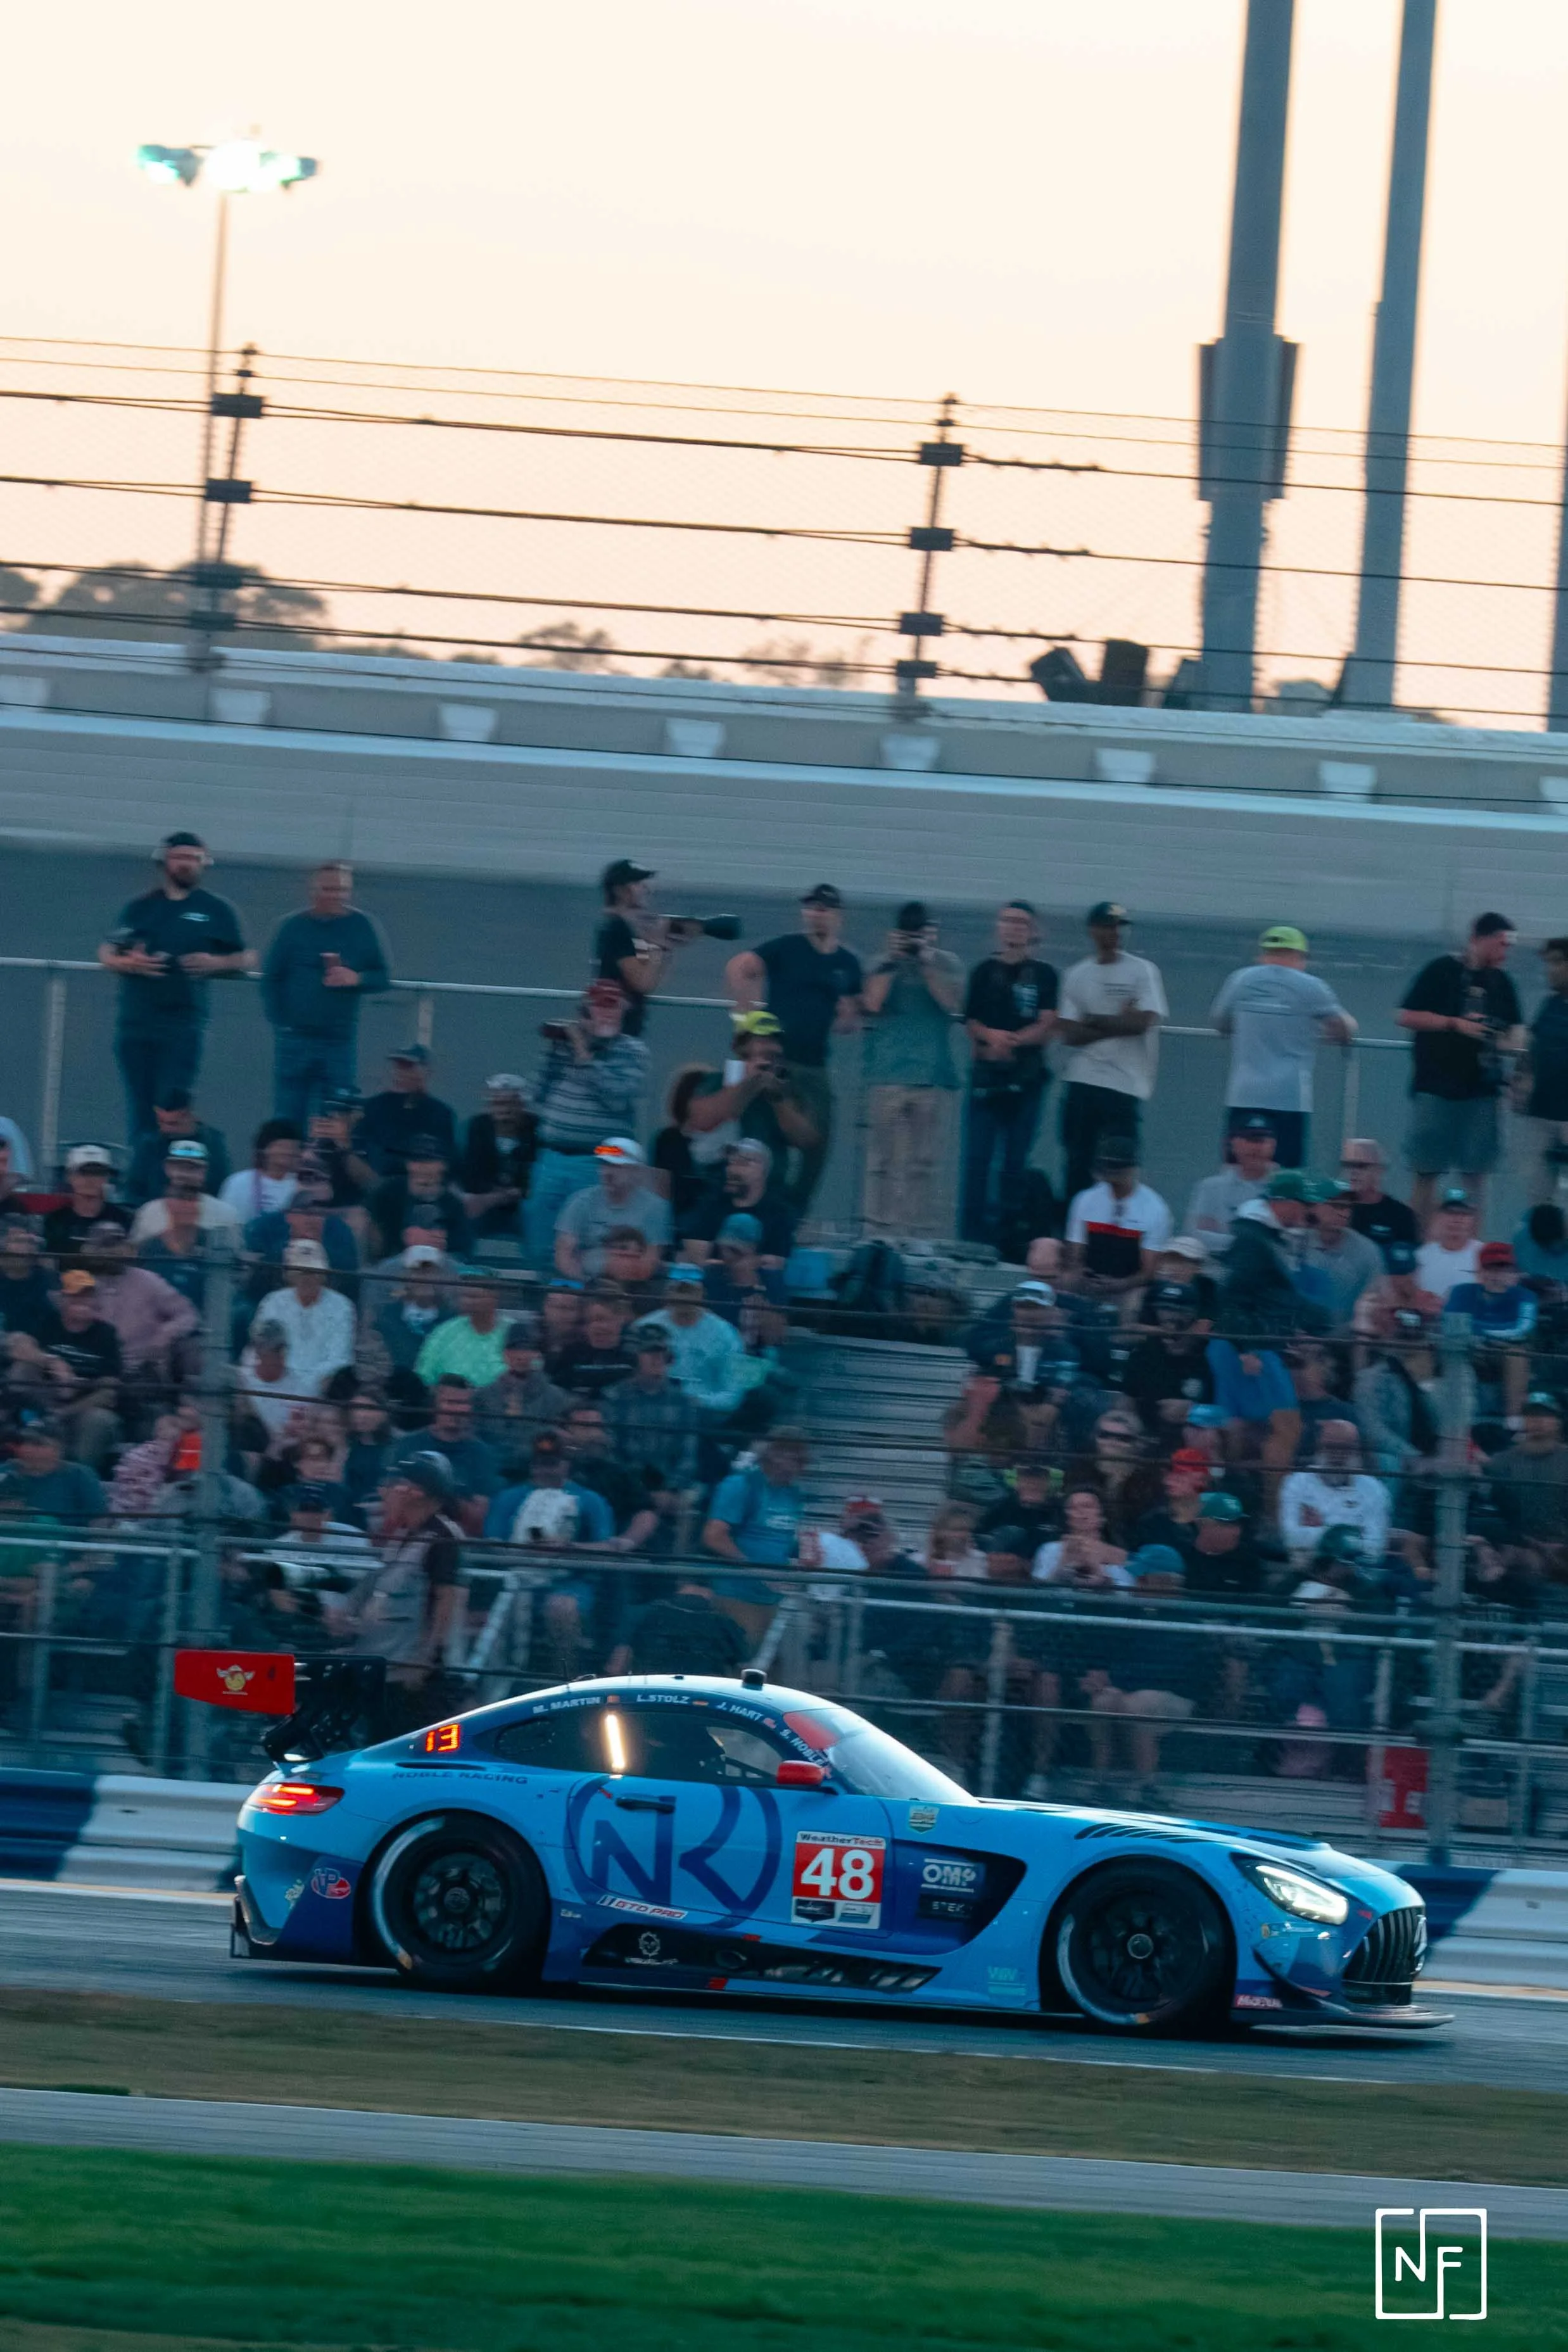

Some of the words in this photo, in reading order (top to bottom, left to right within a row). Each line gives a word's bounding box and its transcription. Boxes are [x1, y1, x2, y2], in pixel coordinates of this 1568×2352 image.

[550, 1697, 602, 1709] MARTIN
[716, 1702, 728, 1710] J.
[729, 1704, 764, 1721] HART
[426, 1723, 460, 1752] 13
[790, 1737, 825, 1767] NOBLE
[458, 1773, 528, 1785] RACING
[800, 1847, 875, 1900] 48
[922, 1864, 977, 1887] OMP
[614, 1900, 648, 1912] GTD
[649, 1907, 685, 1919] PRO
